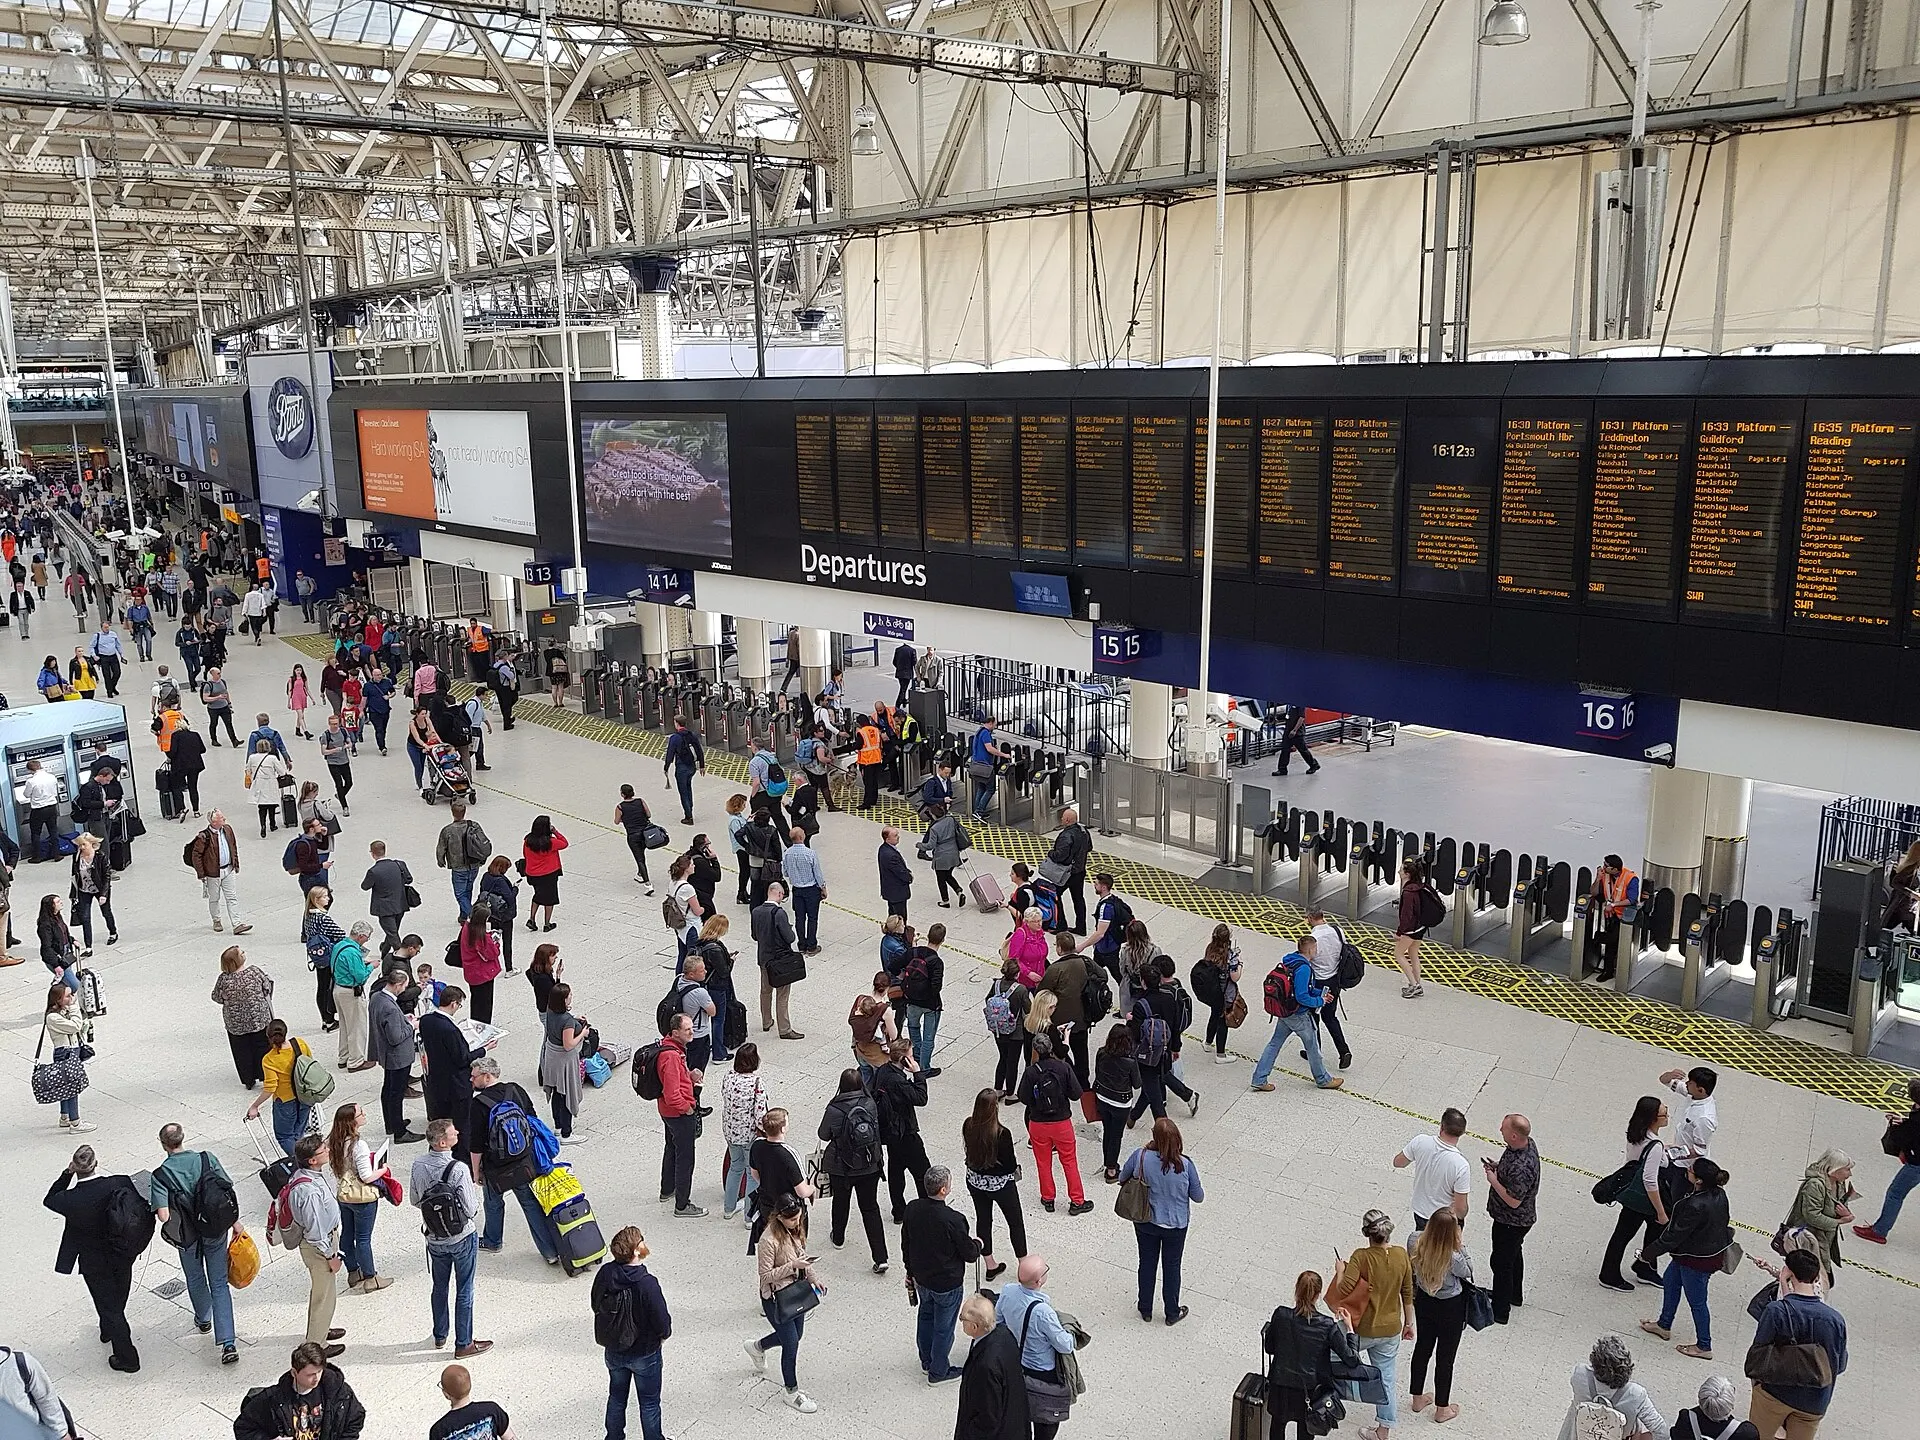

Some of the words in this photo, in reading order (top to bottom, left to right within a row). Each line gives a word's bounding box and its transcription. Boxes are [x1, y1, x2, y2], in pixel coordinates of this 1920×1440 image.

[275, 393, 305, 443] Boots
[1507, 420, 1530, 429] 16:30
[1536, 420, 1570, 429] Platform
[1600, 421, 1624, 429] 16:31
[1632, 421, 1669, 430] Platform
[1701, 422, 1729, 431] 16:33
[1736, 422, 1776, 432] Platform
[1812, 422, 1843, 432] 16:35
[1850, 422, 1895, 433] Platform
[1506, 431, 1555, 441] Portsmouth
[1558, 432, 1574, 441] Hbr
[1599, 432, 1649, 443] Teddington
[1699, 434, 1744, 444] Guildford
[1809, 435, 1852, 446] Reading
[371, 440, 386, 456] Hard
[387, 441, 412, 461] working
[413, 440, 426, 458] ISA
[1821, 447, 1846, 455] Ascot
[448, 446, 460, 461] not
[460, 444, 482, 465] hardly
[482, 446, 514, 469] working
[1697, 454, 1718, 462] Calling
[1748, 455, 1764, 463] Page
[1808, 456, 1831, 464] Calling
[1863, 457, 1881, 465] Page
[1807, 464, 1845, 472] Vauxhall
[180, 472, 187, 480] 9
[612, 469, 630, 479] Great
[631, 469, 646, 480] food
[647, 471, 653, 480] is
[654, 472, 675, 483] simple
[675, 473, 695, 483] when
[1696, 470, 1727, 478] Clapham
[1806, 473, 1840, 482] Clapham
[200, 482, 211, 490] 10
[1695, 478, 1737, 486] Earlsfield
[1805, 481, 1844, 489] Richmond
[618, 489, 630, 498] you
[631, 488, 647, 497] start
[648, 489, 662, 499] with
[663, 489, 675, 500] the
[676, 490, 691, 501] best
[1695, 486, 1733, 494] Wimbledon
[1805, 490, 1851, 498] Twickenham
[224, 492, 234, 502] 11
[1694, 494, 1728, 502] Surbiton
[1803, 498, 1836, 506] Feltham
[1693, 502, 1727, 511] Hinchley
[1693, 510, 1727, 519] Claygate
[1803, 507, 1836, 515] Ashford
[1839, 508, 1877, 518] (Surrey)
[1692, 518, 1721, 526] Oxshott
[1802, 515, 1834, 523] Staines
[1691, 526, 1718, 534] Cobham
[1728, 528, 1750, 536] Stoke
[1801, 523, 1826, 533] Egham
[1690, 534, 1728, 544] Effingham
[1800, 532, 1837, 542] Virginia
[1839, 534, 1864, 542] Water
[371, 537, 384, 548] 12
[1690, 542, 1720, 551] Horsley
[1799, 540, 1843, 550] Longcross
[1689, 550, 1719, 558] Clandon
[1799, 548, 1850, 559] Sunningdale
[801, 544, 927, 587] Departures
[1689, 558, 1715, 566] London
[1798, 557, 1821, 565] Ascot
[525, 567, 533, 582] 13
[537, 567, 551, 581] 13
[1695, 566, 1735, 576] Guildford.
[1797, 565, 1830, 574] Martins
[1832, 568, 1857, 576] Heron
[648, 573, 659, 589] 14
[663, 573, 679, 589] 14
[1796, 573, 1837, 583] Bracknell
[1795, 581, 1837, 592] Wokingham
[1686, 590, 1704, 600] SWR
[1803, 590, 1839, 601] Reading.
[1794, 599, 1814, 609] SWR
[1809, 611, 1843, 621] coaches
[1100, 634, 1119, 657] 15
[1125, 634, 1140, 656] 15
[1583, 702, 1615, 730] 16
[1622, 701, 1634, 729] 16
[26, 748, 45, 756] TICKETS
[1261, 916, 1293, 926] CLEAR
[1471, 974, 1510, 987] CLEAR
[1632, 1019, 1677, 1034] CLEAR
[1641, 1015, 1678, 1028] KEEP
[1392, 1107, 1417, 1118] PLEASE
[1418, 1114, 1433, 1122] WAIT
[1566, 1165, 1582, 1173] WAIT
[1583, 1171, 1605, 1180] BEHIN
[1734, 1222, 1755, 1232] WAIT
[1756, 1229, 1775, 1238] BEHI
[1896, 1277, 1920, 1288] PLEA
